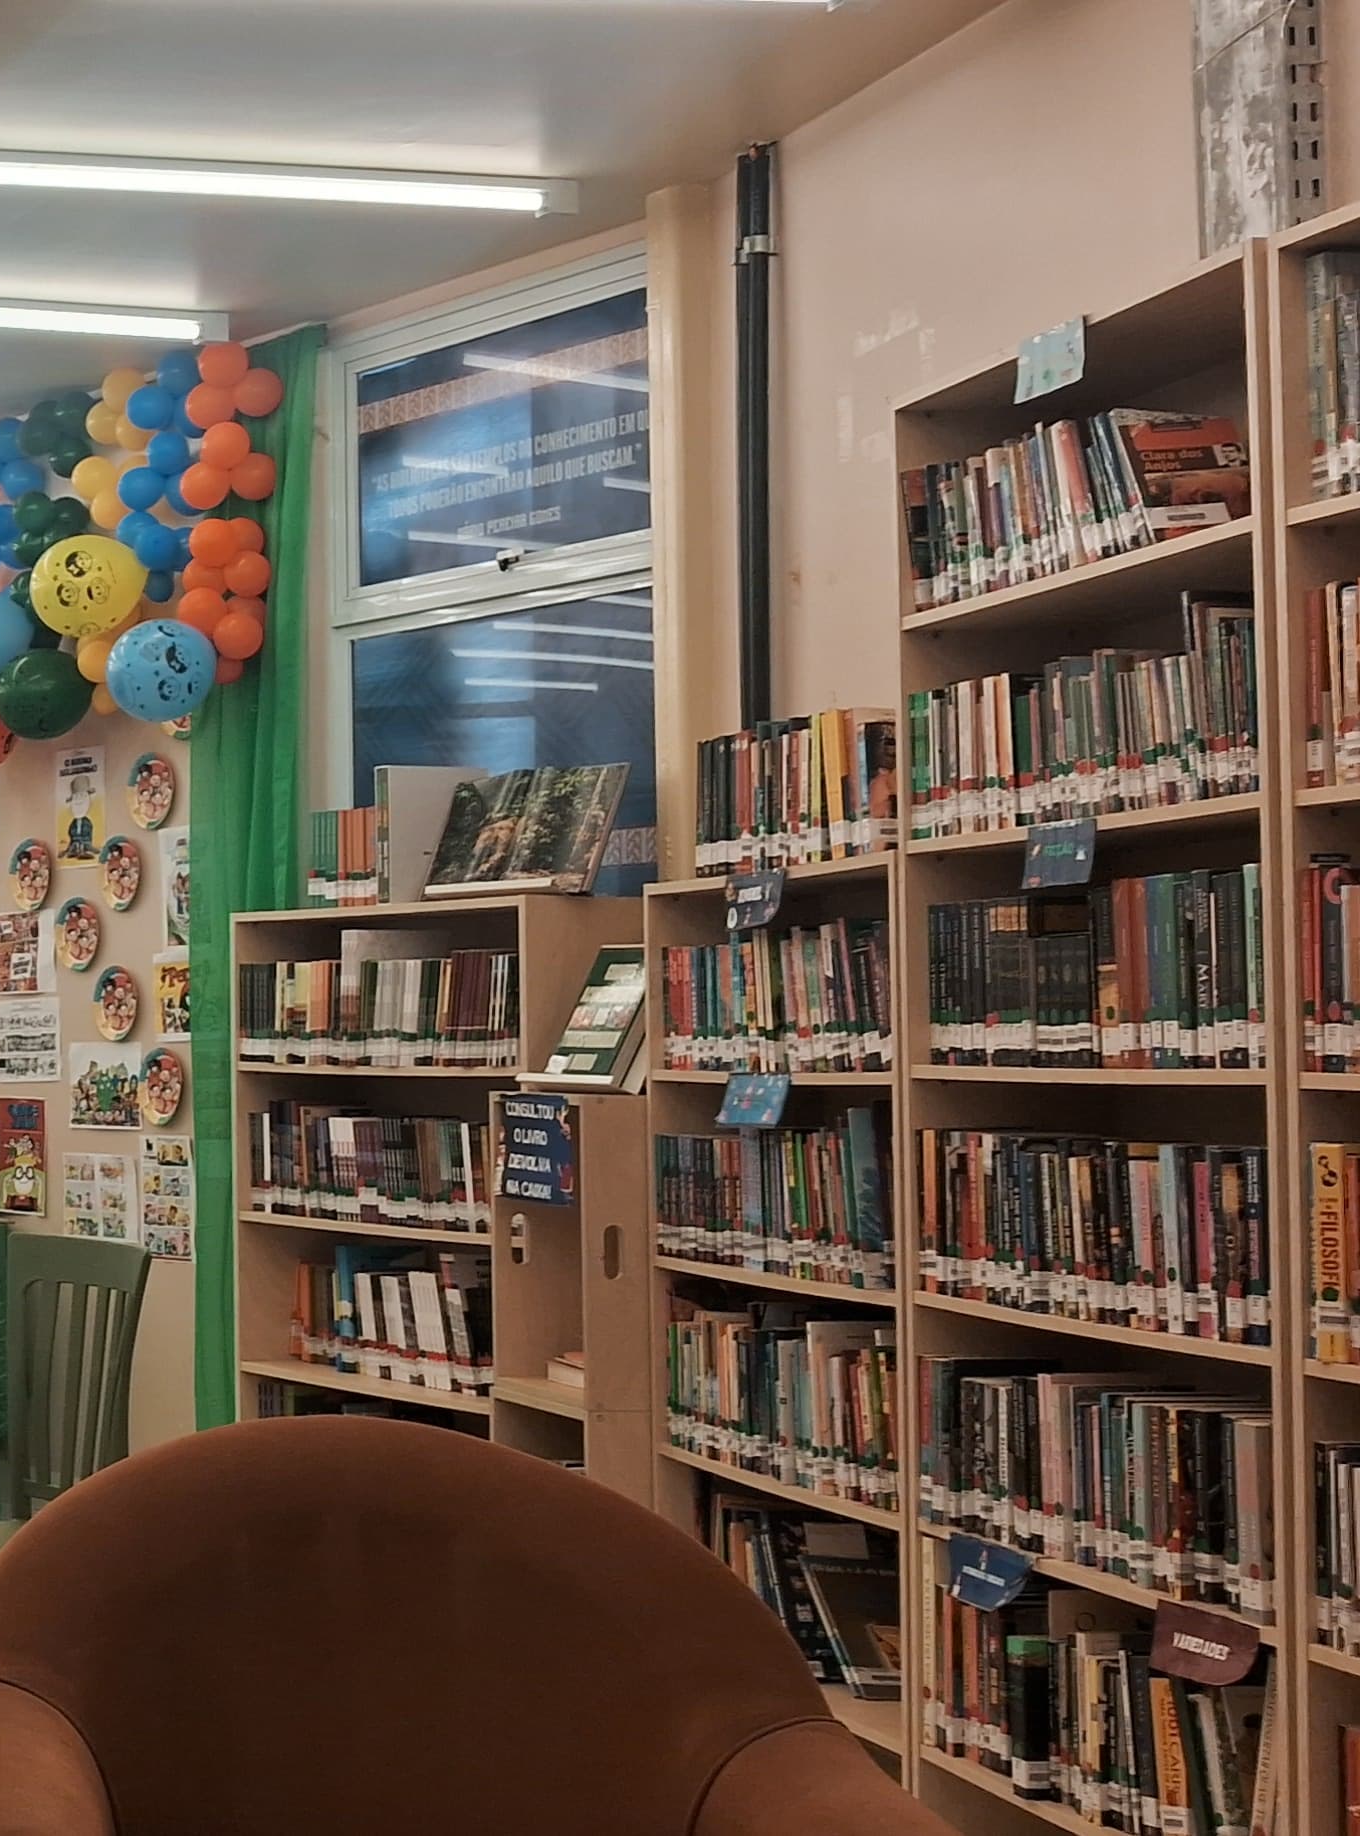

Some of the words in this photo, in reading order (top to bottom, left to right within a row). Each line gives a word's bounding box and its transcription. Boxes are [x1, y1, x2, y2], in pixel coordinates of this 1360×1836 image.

[534, 417, 616, 455] CONHECIMENTO
[618, 412, 635, 436] EM
[1141, 451, 1175, 460] Clara
[1179, 448, 1203, 459] dos
[526, 461, 562, 488] AQUILO
[564, 456, 586, 480] QUE
[1144, 461, 1181, 471] Anjos
[505, 1102, 555, 1120] CONSULTOU
[513, 1127, 521, 1144] O
[522, 1128, 548, 1146] LIVRO
[507, 1152, 552, 1173] DEVOLVA
[505, 1179, 520, 1195] NA
[1320, 1211, 1340, 1288] FILOSOFI
[1173, 1631, 1230, 1661] VARIEDADES
